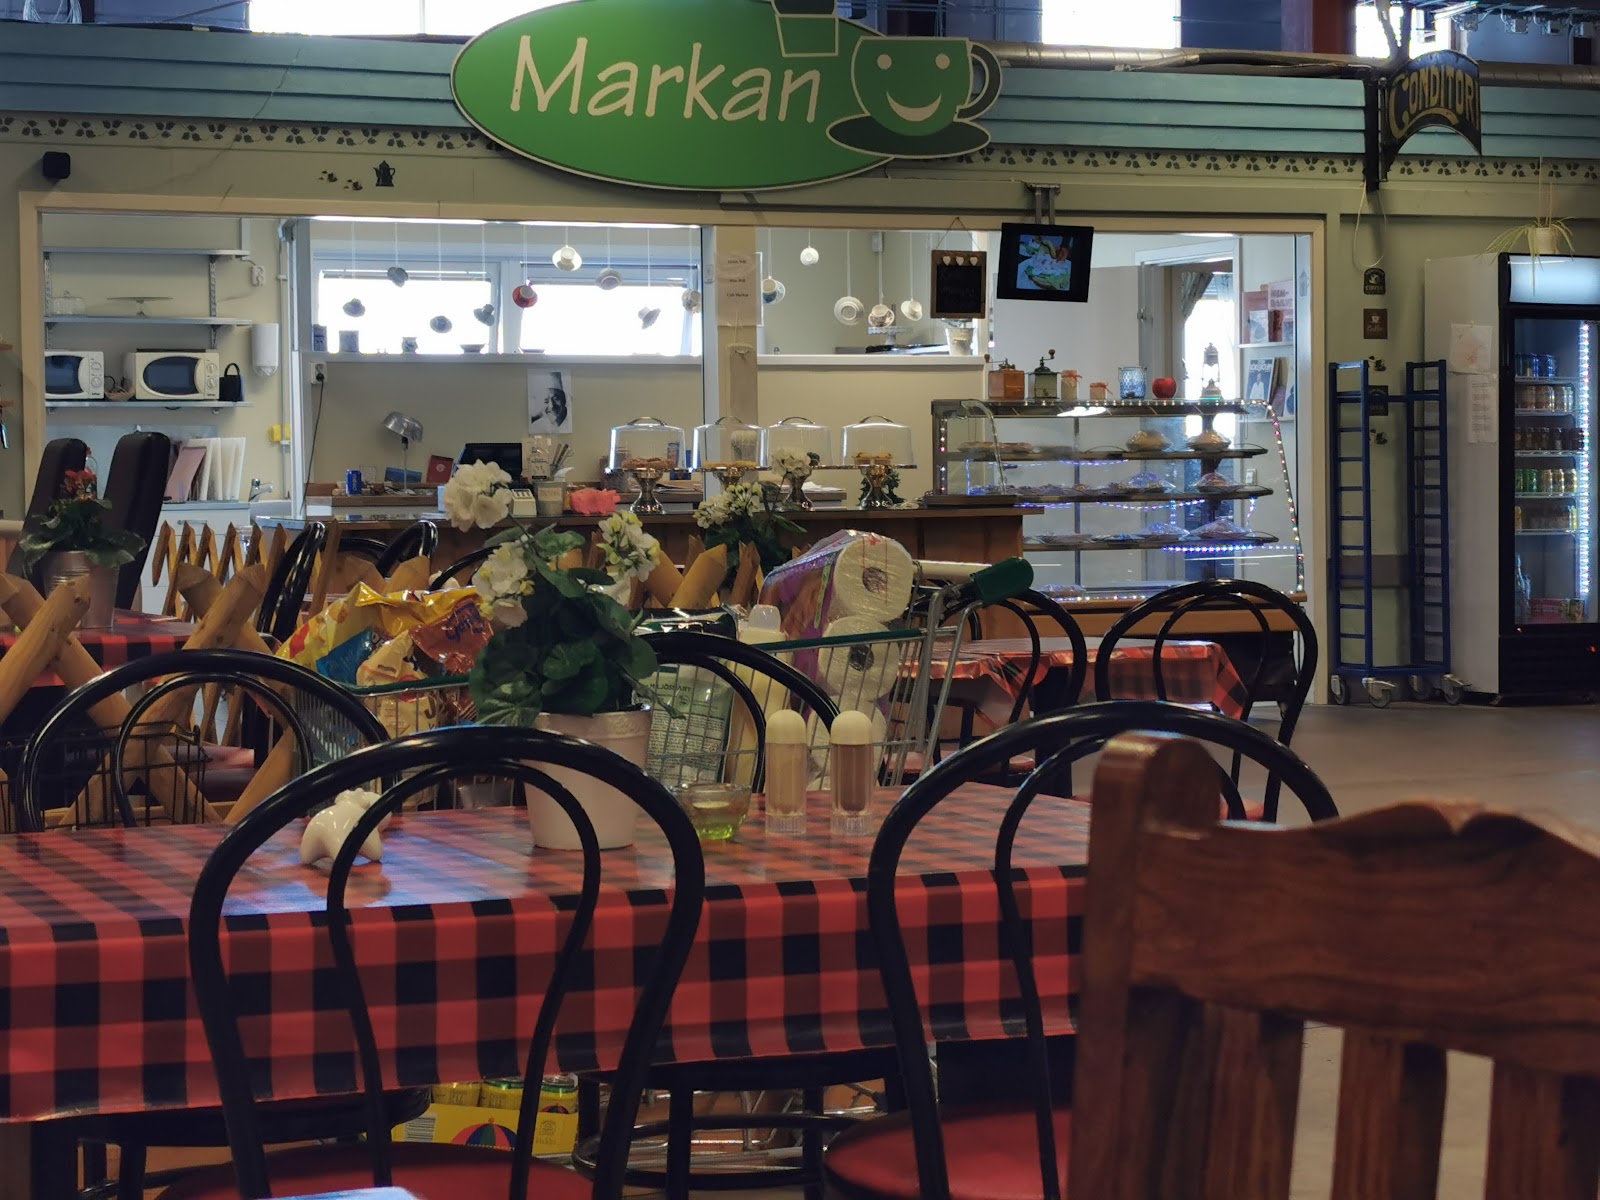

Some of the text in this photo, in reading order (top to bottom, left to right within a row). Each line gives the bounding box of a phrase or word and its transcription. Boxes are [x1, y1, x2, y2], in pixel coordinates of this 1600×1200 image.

[509, 34, 821, 123] Markan
[1388, 64, 1480, 139] CONDITORI
[650, 683, 692, 692] MLJÖSART
